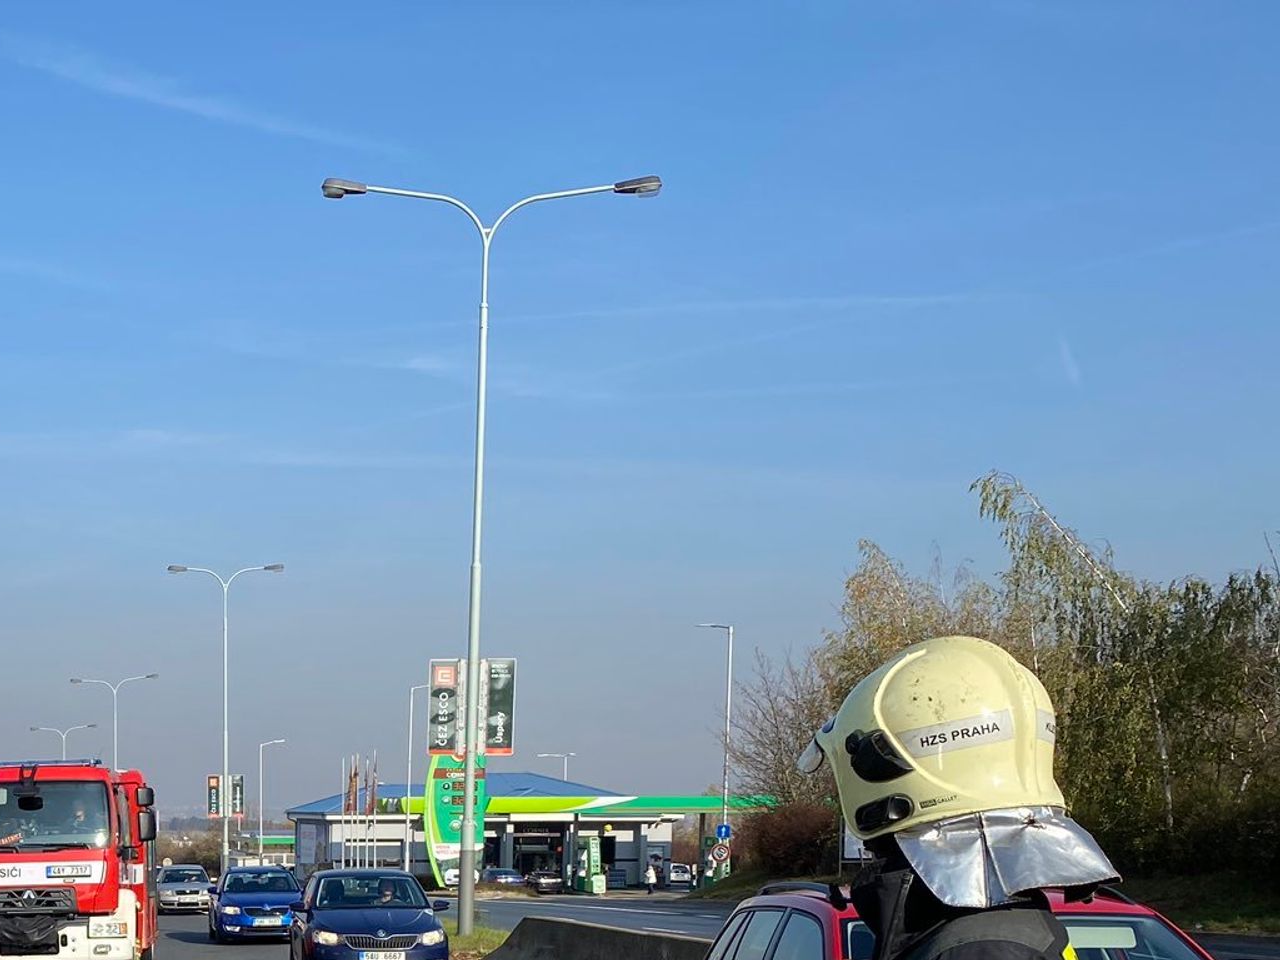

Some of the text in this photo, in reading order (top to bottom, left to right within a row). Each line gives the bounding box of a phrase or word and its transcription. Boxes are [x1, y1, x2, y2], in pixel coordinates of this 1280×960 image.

[434, 692, 449, 746] ČEZ ESCO
[920, 722, 1001, 748] HZS PRAHA
